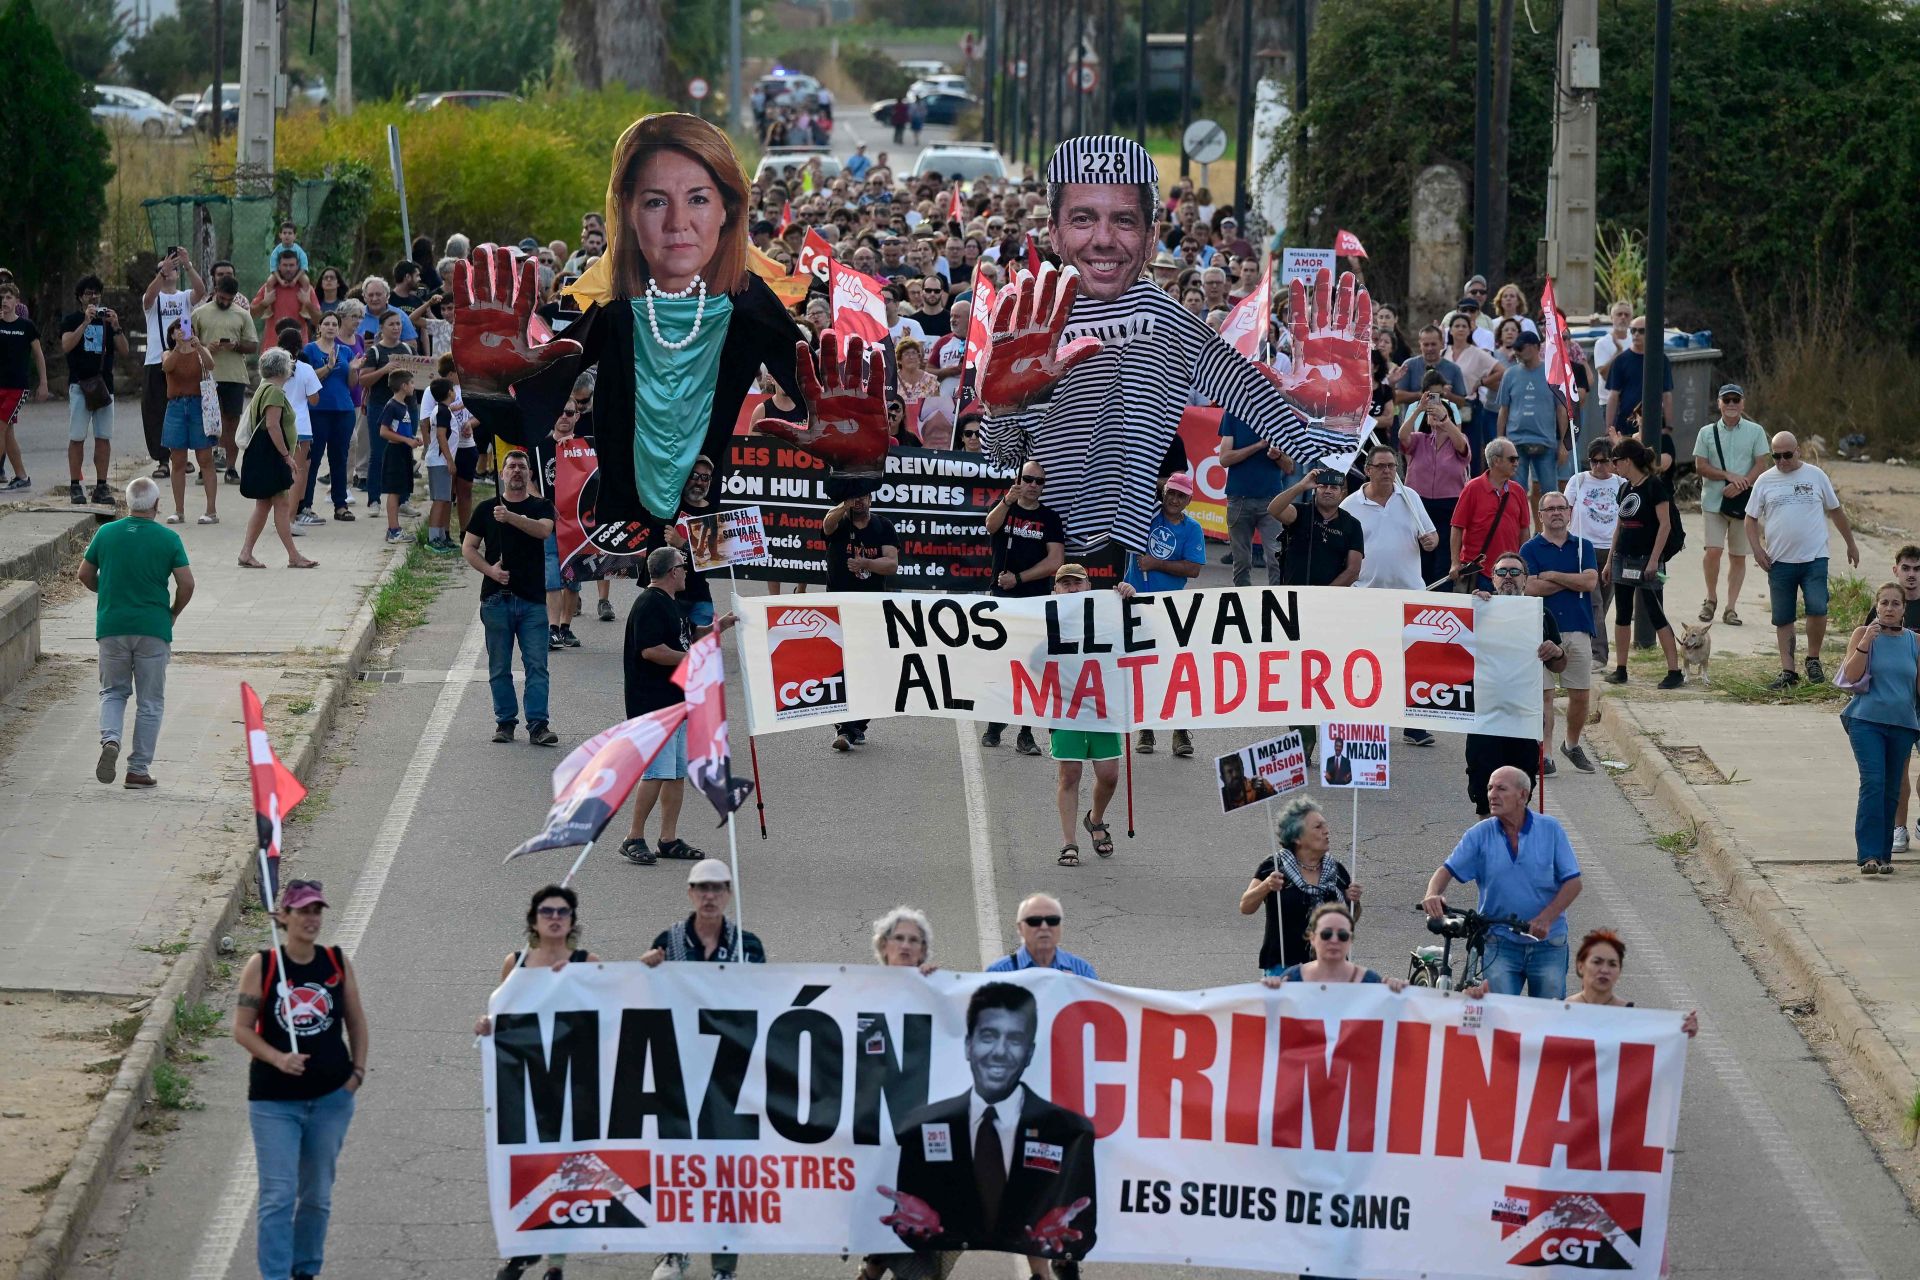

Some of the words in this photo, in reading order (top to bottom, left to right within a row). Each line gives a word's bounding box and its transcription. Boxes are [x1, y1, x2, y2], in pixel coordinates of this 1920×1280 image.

[1083, 153, 1126, 174] 228
[799, 246, 829, 282] CG
[1294, 259, 1323, 267] AMOR
[563, 447, 582, 458] PAÍS
[731, 447, 770, 466] LES
[777, 448, 825, 469] NOS
[885, 456, 1018, 479] REIVINDICA
[770, 478, 809, 498] HUI
[872, 483, 965, 506] OSTRES
[720, 511, 739, 522] SOLS
[741, 510, 748, 519] EL
[736, 516, 758, 526] POBLE
[779, 513, 823, 529] Auton
[931, 521, 990, 536] Interve
[598, 521, 626, 543] COOR
[611, 531, 628, 547] DEL
[628, 528, 650, 549] SECT
[723, 527, 746, 539] SALVA
[748, 525, 758, 533] AL
[740, 532, 762, 543] POBLE
[905, 541, 992, 556] l'Administr
[926, 563, 945, 576] de
[882, 598, 1008, 651] NOS
[1044, 589, 1301, 655] LLEVAN
[779, 676, 843, 707] CGT
[894, 653, 975, 714] AL
[1010, 649, 1383, 722] MATADERO
[1410, 681, 1472, 708] CGT
[1328, 723, 1387, 742] CRIMINAL
[1257, 734, 1300, 761] MAZÓN
[1346, 740, 1387, 761] MAZÓN
[1259, 752, 1304, 777] PRISIÓN
[495, 985, 932, 1146] MAZÓN
[1050, 1000, 1664, 1173] CRIMINAL
[1026, 1146, 1062, 1159] TANCAT
[655, 1154, 713, 1190] LES
[716, 1155, 856, 1192] NOSTRES
[547, 1198, 611, 1226] CGT
[656, 1191, 698, 1225] DE
[702, 1191, 782, 1225] FANG
[1119, 1178, 1171, 1214] LES
[1180, 1181, 1277, 1221] SEUES
[1285, 1190, 1322, 1226] DE
[1335, 1194, 1411, 1231] SANG
[1494, 1200, 1529, 1214] TANCAT
[1540, 1236, 1601, 1264] CGT
